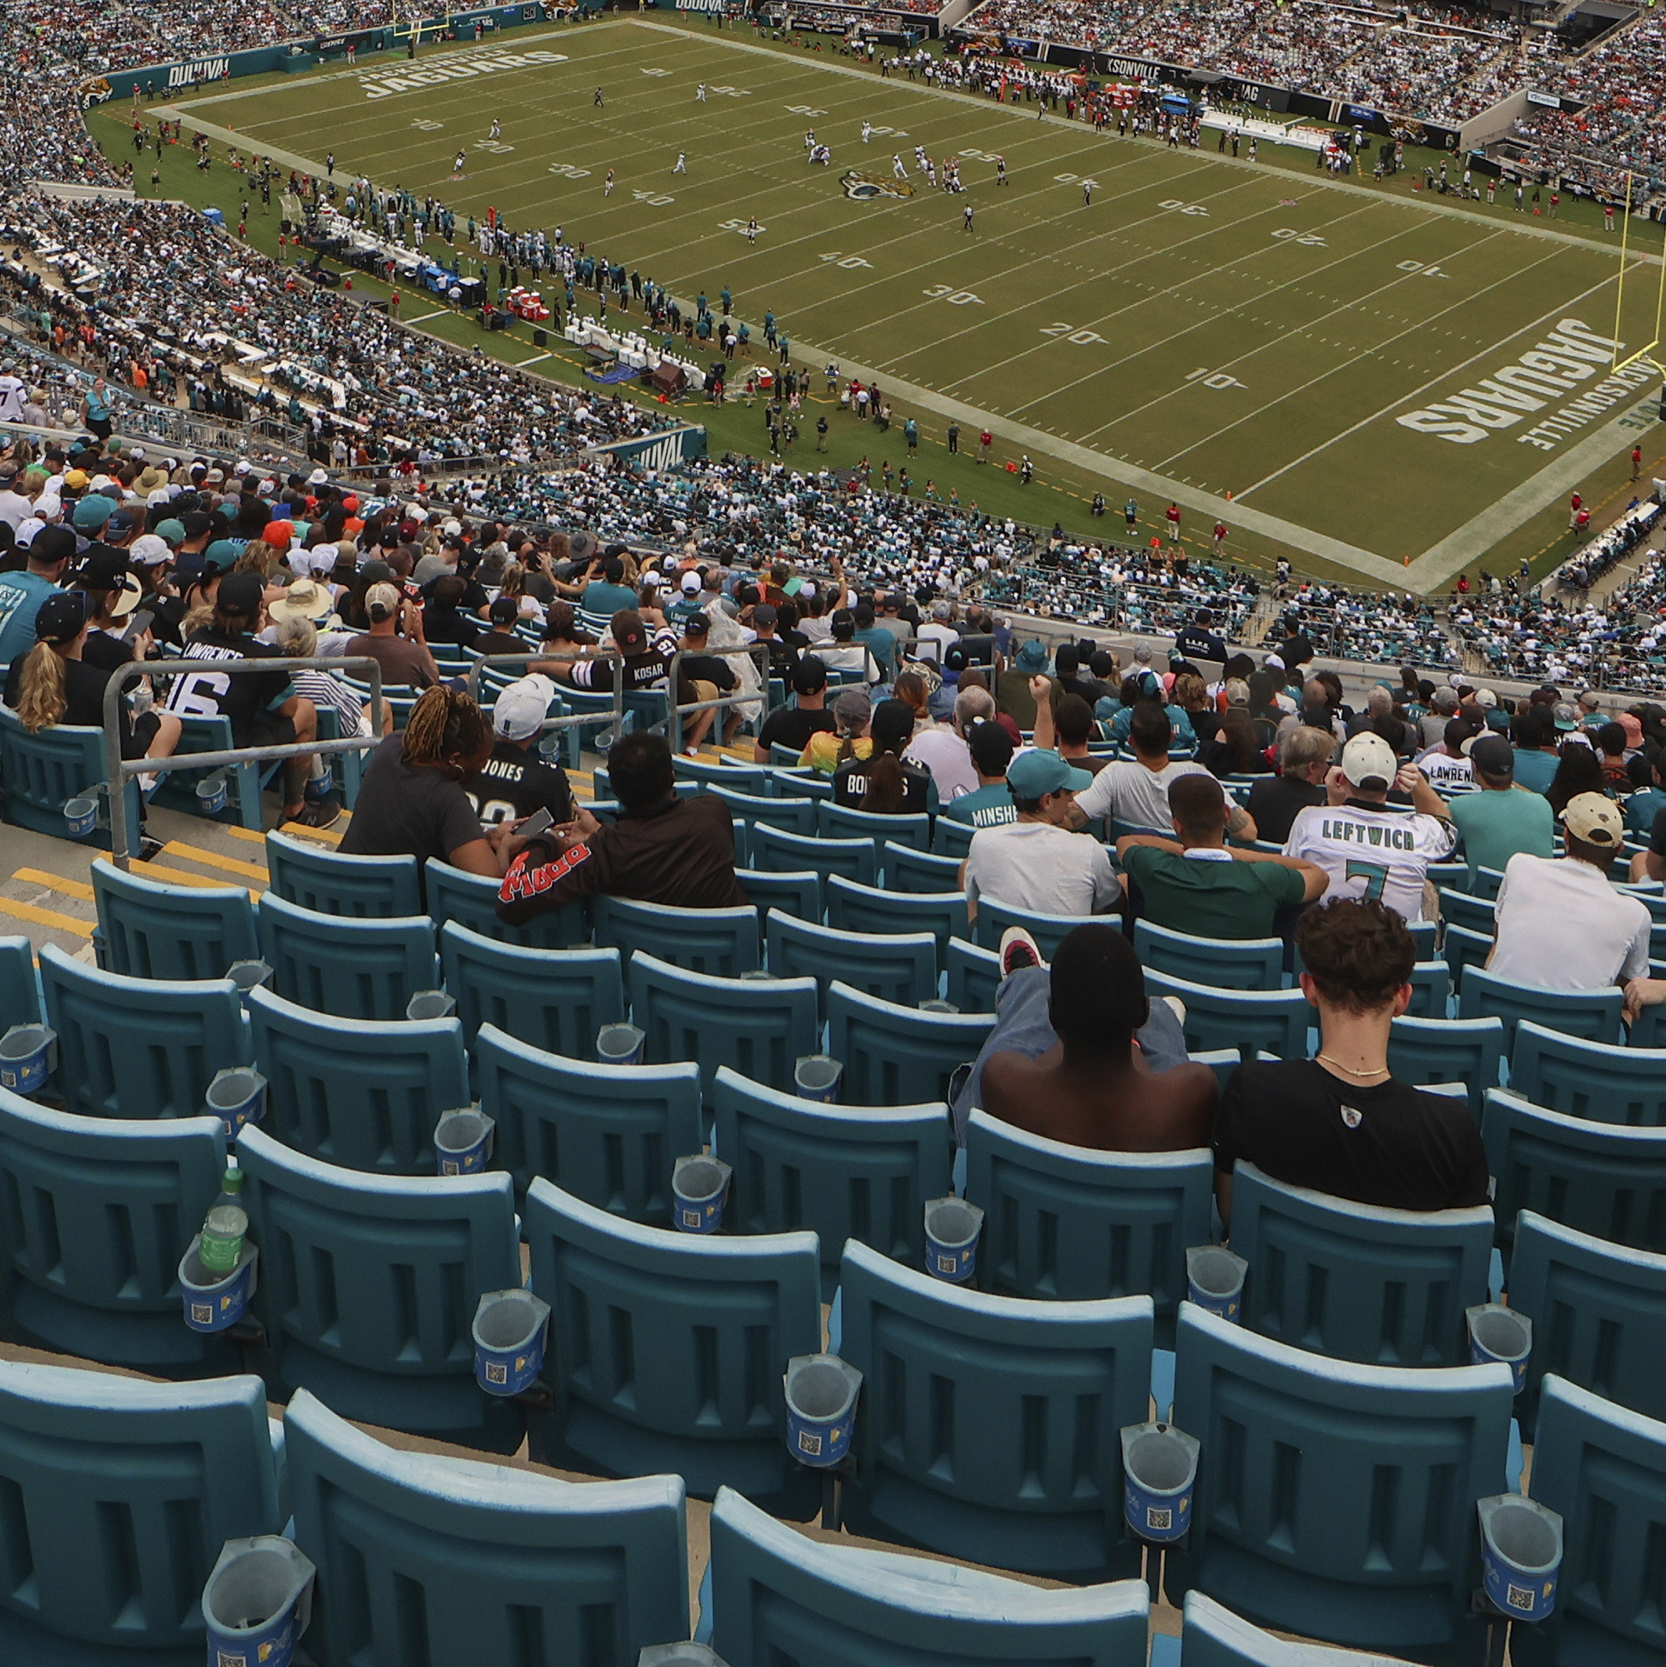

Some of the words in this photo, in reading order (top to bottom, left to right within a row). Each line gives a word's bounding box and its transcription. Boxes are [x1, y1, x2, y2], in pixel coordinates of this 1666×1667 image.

[358, 48, 513, 85] JACKSONVILLE
[364, 50, 569, 98] JAGUARS
[922, 283, 976, 305] 30
[1039, 322, 1100, 346] 20
[1185, 367, 1237, 390] 10
[1396, 317, 1627, 444] JAGUARS
[183, 641, 244, 661] LAWRENCE
[634, 664, 664, 681] KOSAR
[480, 758, 524, 783] JONES
[1321, 818, 1415, 852] LEFTWICH
[1345, 858, 1389, 903] 7
